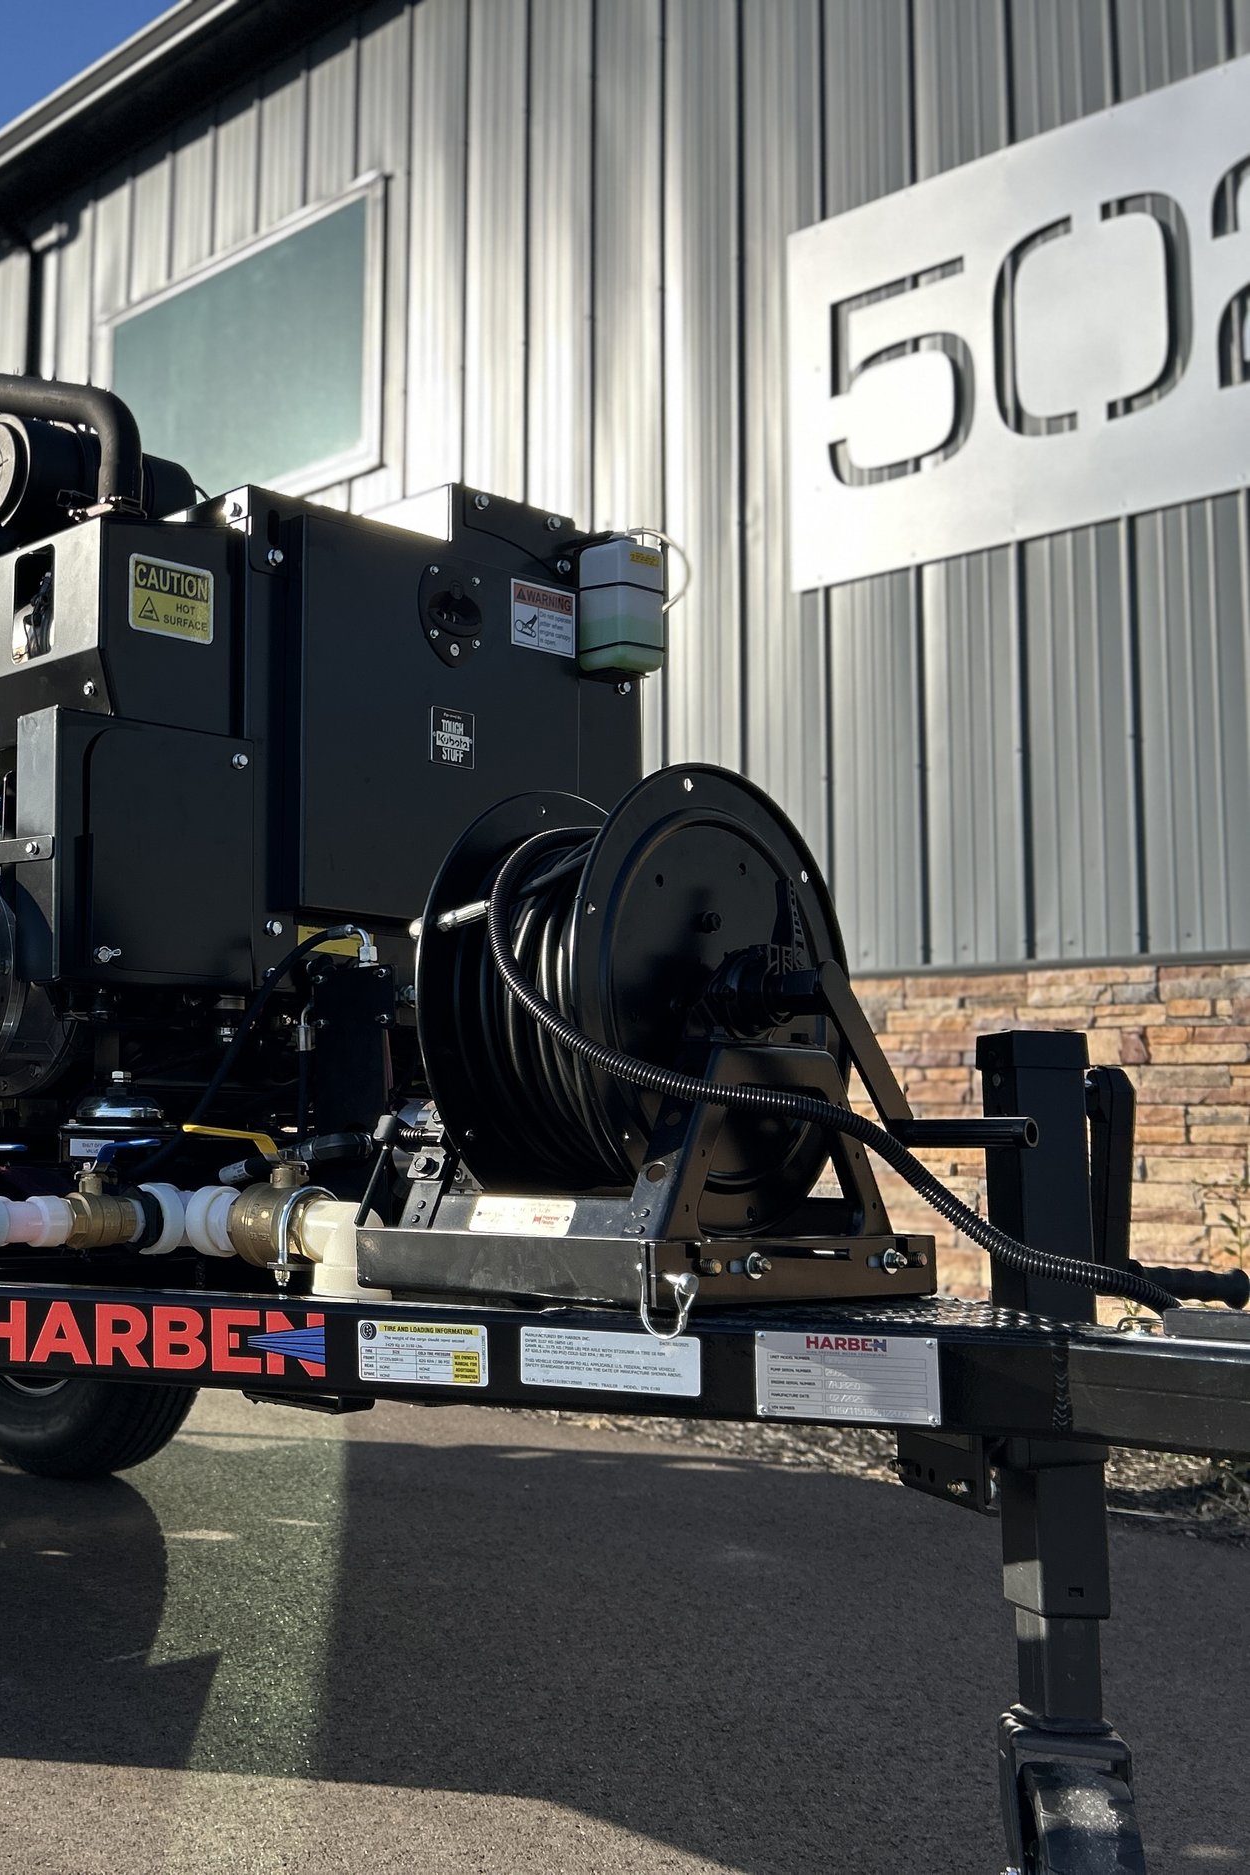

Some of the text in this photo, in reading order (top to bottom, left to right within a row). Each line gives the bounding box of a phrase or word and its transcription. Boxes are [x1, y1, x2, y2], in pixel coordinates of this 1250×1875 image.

[136, 564, 208, 601] CAUTION
[176, 603, 195, 615] HOT
[527, 590, 571, 612] WARNING
[163, 614, 208, 632] SURFACE
[441, 719, 463, 735] TOUGH
[438, 734, 468, 748] Kubota
[442, 747, 463, 762] STUFF
[435, 1327, 473, 1335] INFORMATION
[806, 1336, 887, 1352] HARBEN
